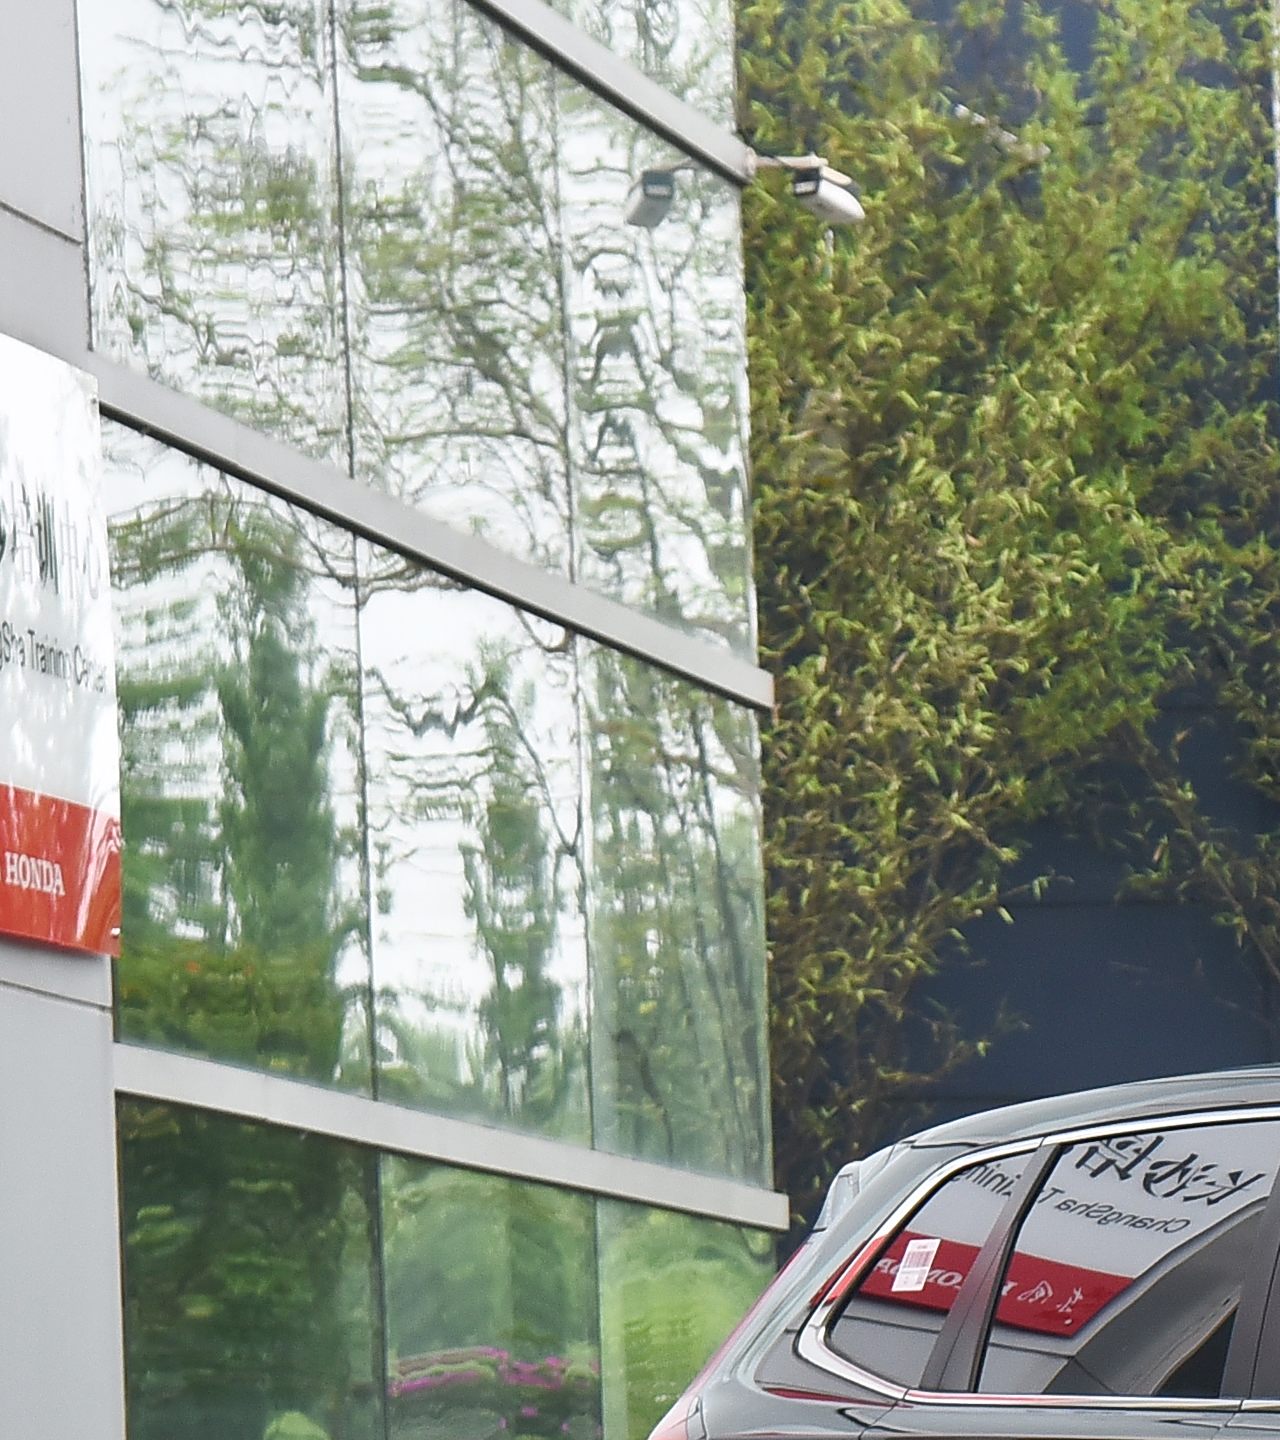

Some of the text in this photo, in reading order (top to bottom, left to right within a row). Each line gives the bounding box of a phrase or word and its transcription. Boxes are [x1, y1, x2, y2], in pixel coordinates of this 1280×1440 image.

[0, 481, 102, 600] 培训中心
[0, 620, 26, 671] Sha
[5, 851, 66, 896] HONDA
